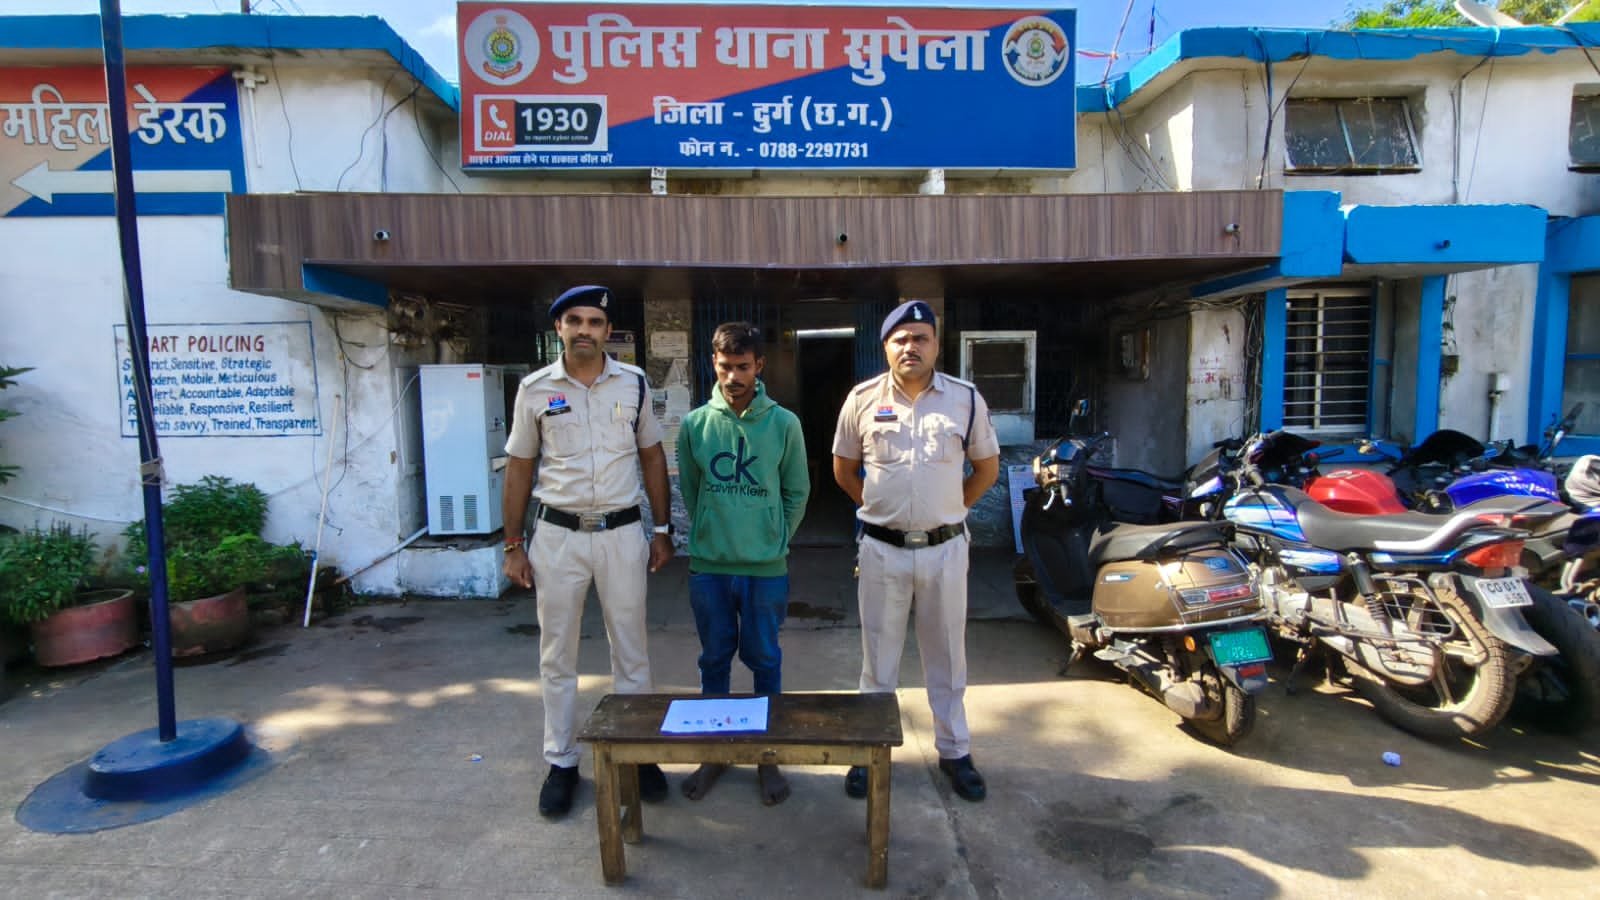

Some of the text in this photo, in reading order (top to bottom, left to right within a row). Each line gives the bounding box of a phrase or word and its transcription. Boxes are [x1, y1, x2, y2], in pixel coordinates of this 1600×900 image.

[548, 12, 990, 86] पुलिस थाना सुपेला
[0, 83, 227, 150] महिल डेस्क
[521, 108, 588, 132] 1930
[652, 95, 726, 125] जिला
[751, 95, 793, 133] दुर्ग
[800, 96, 893, 132] (छ.ग.)
[484, 131, 512, 141] DIAL
[679, 137, 716, 157] फोन
[720, 140, 740, 157] न.
[759, 142, 869, 158] 0788-2297731
[188, 335, 265, 353] POLICING
[221, 356, 272, 371] Strategic
[151, 375, 179, 387] odern,
[218, 373, 277, 384] Meticulous
[154, 388, 178, 401] lert,
[245, 385, 295, 398] Adaptable
[153, 402, 188, 416] eliable,
[249, 400, 295, 413] Resilient
[255, 417, 318, 433] Transparent
[710, 436, 759, 486] ck
[740, 484, 768, 497] Klein
